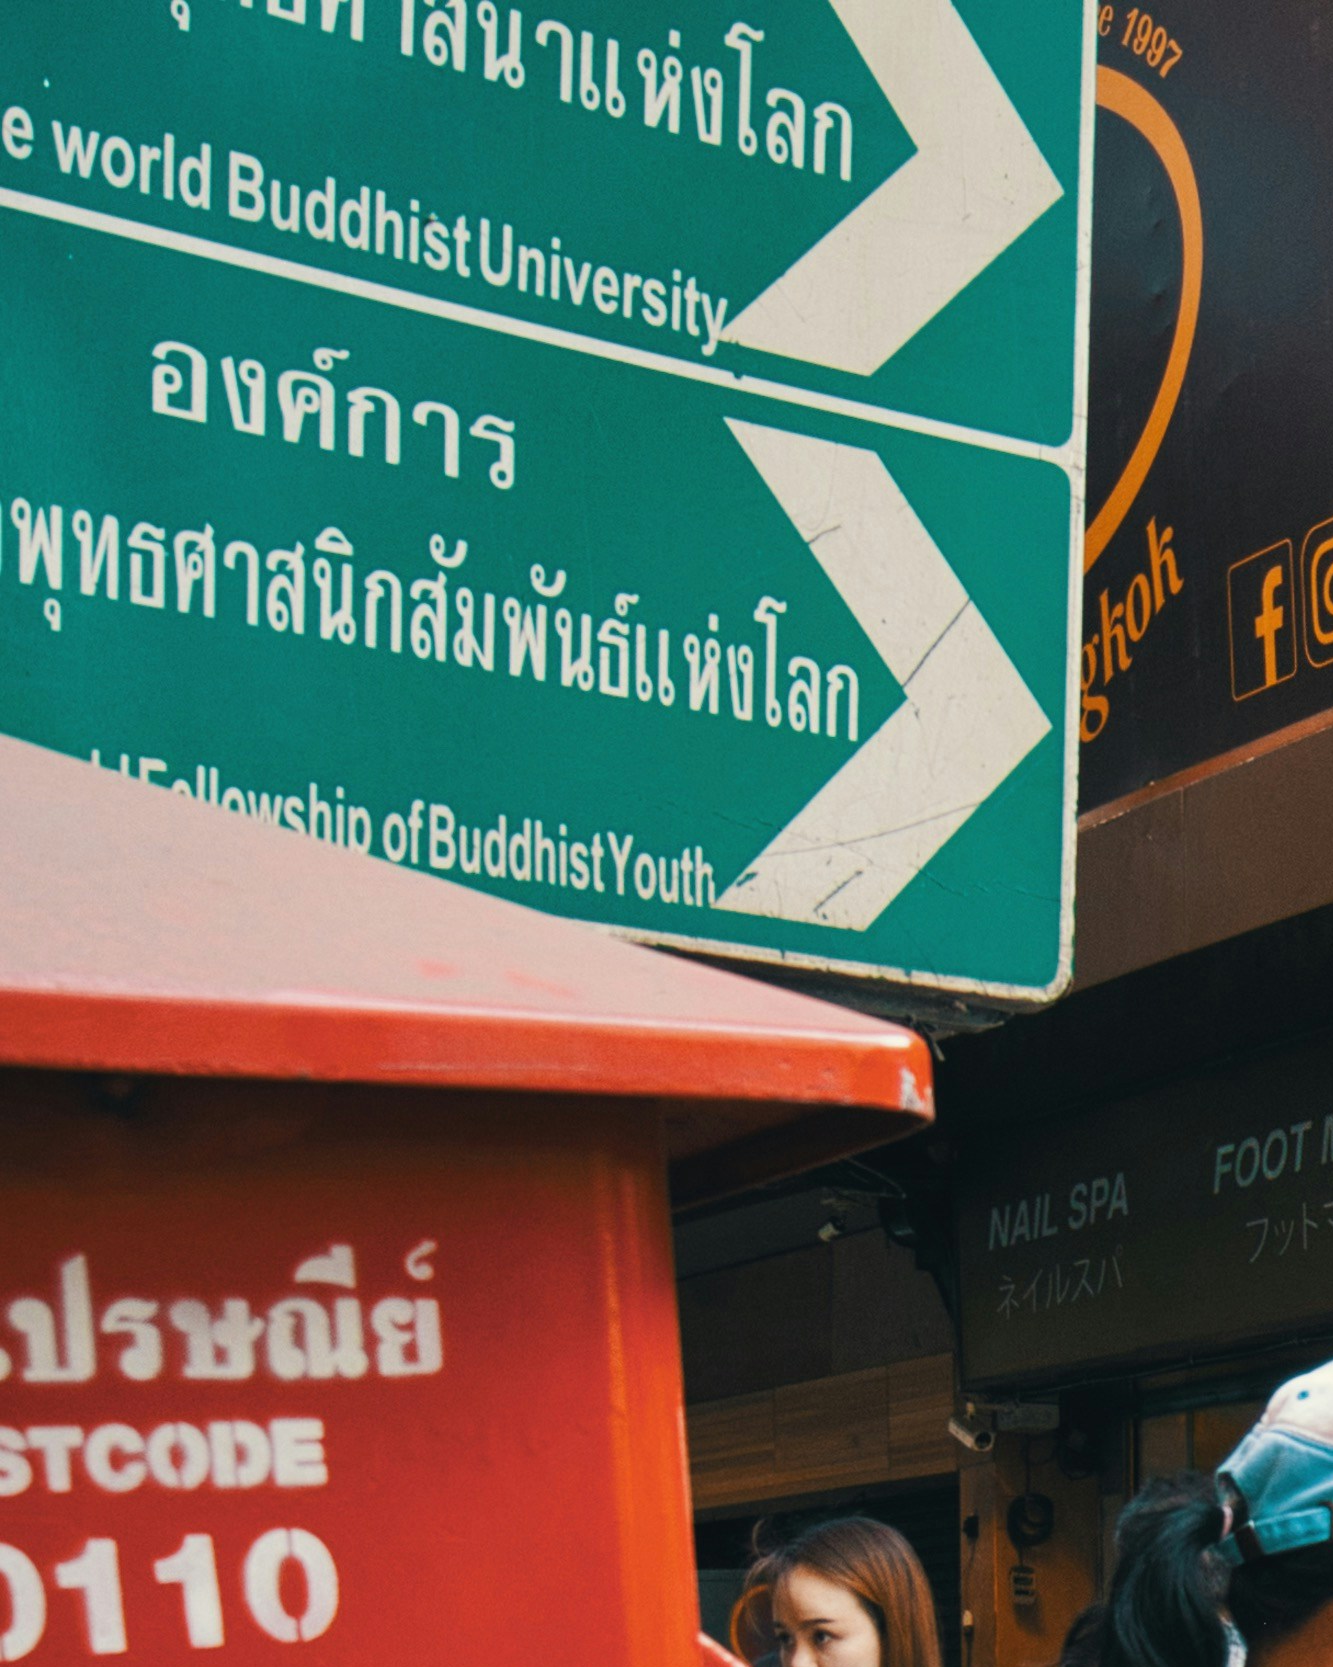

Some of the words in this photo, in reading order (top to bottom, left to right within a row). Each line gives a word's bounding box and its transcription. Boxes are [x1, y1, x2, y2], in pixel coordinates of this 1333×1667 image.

[1121, 7, 1184, 78] 1997
[52, 120, 212, 210] world
[229, 150, 471, 279] Buddhist
[480, 217, 728, 356] University
[151, 340, 516, 490] องค์การ
[382, 799, 424, 863] of
[428, 803, 605, 894] Buddhist
[607, 831, 716, 908] Youth
[1212, 1121, 1313, 1195] FOOT
[987, 1193, 1058, 1252] NAIL
[1067, 1171, 1130, 1231] SPA
[0, 1239, 444, 1384] ปรษณีย์
[996, 1244, 1125, 1321] ネイルスパ
